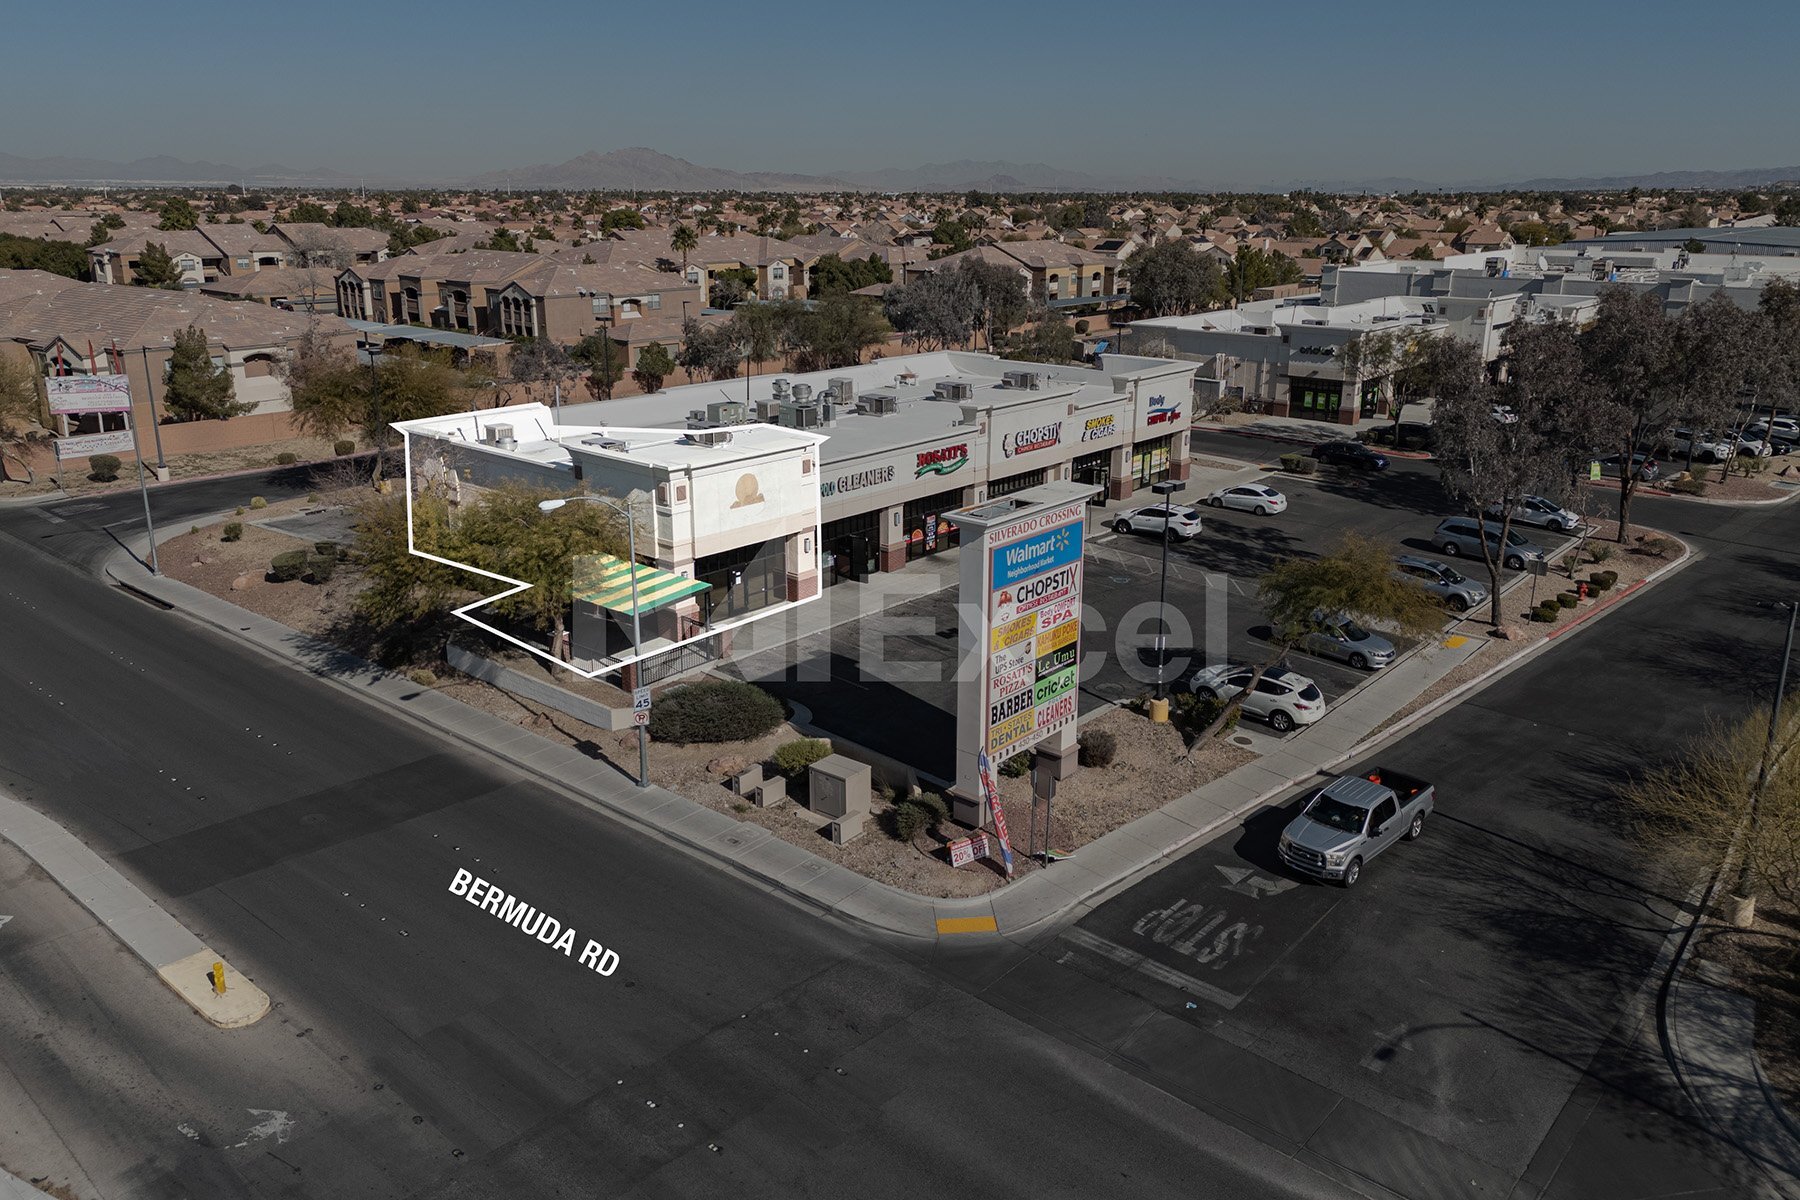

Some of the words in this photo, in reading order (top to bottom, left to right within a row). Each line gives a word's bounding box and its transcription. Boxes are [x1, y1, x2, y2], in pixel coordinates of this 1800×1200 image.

[1085, 414, 1114, 430] SMOKES
[1090, 424, 1116, 440] CIGARS
[1015, 421, 1062, 447] CHOPSTIX
[837, 465, 895, 494] CLEANERS
[989, 519, 1038, 545] SILVERADO
[1039, 506, 1081, 528] CROSSING
[1006, 535, 1055, 566] Walmart
[1007, 560, 1041, 579] Neighborhood
[1040, 555, 1055, 567] Market
[1016, 564, 1078, 603] CHOPSTIX
[997, 616, 1032, 637] SMOKES
[1041, 609, 1073, 628] SPA
[1004, 626, 1035, 646] CIGARS
[995, 653, 1007, 664] The
[995, 661, 1008, 674] UPS
[1038, 660, 1050, 672] Le
[1053, 649, 1075, 665] Umu
[993, 663, 1033, 690] ROSATI'S
[1036, 670, 1075, 700] cricket
[999, 679, 1026, 698] PIZZA
[635, 698, 650, 708] 45
[991, 688, 1033, 726] BARBER
[1037, 695, 1073, 728] CLEANERS
[991, 720, 1032, 750] DENTAL
[973, 844, 987, 857] OFF
